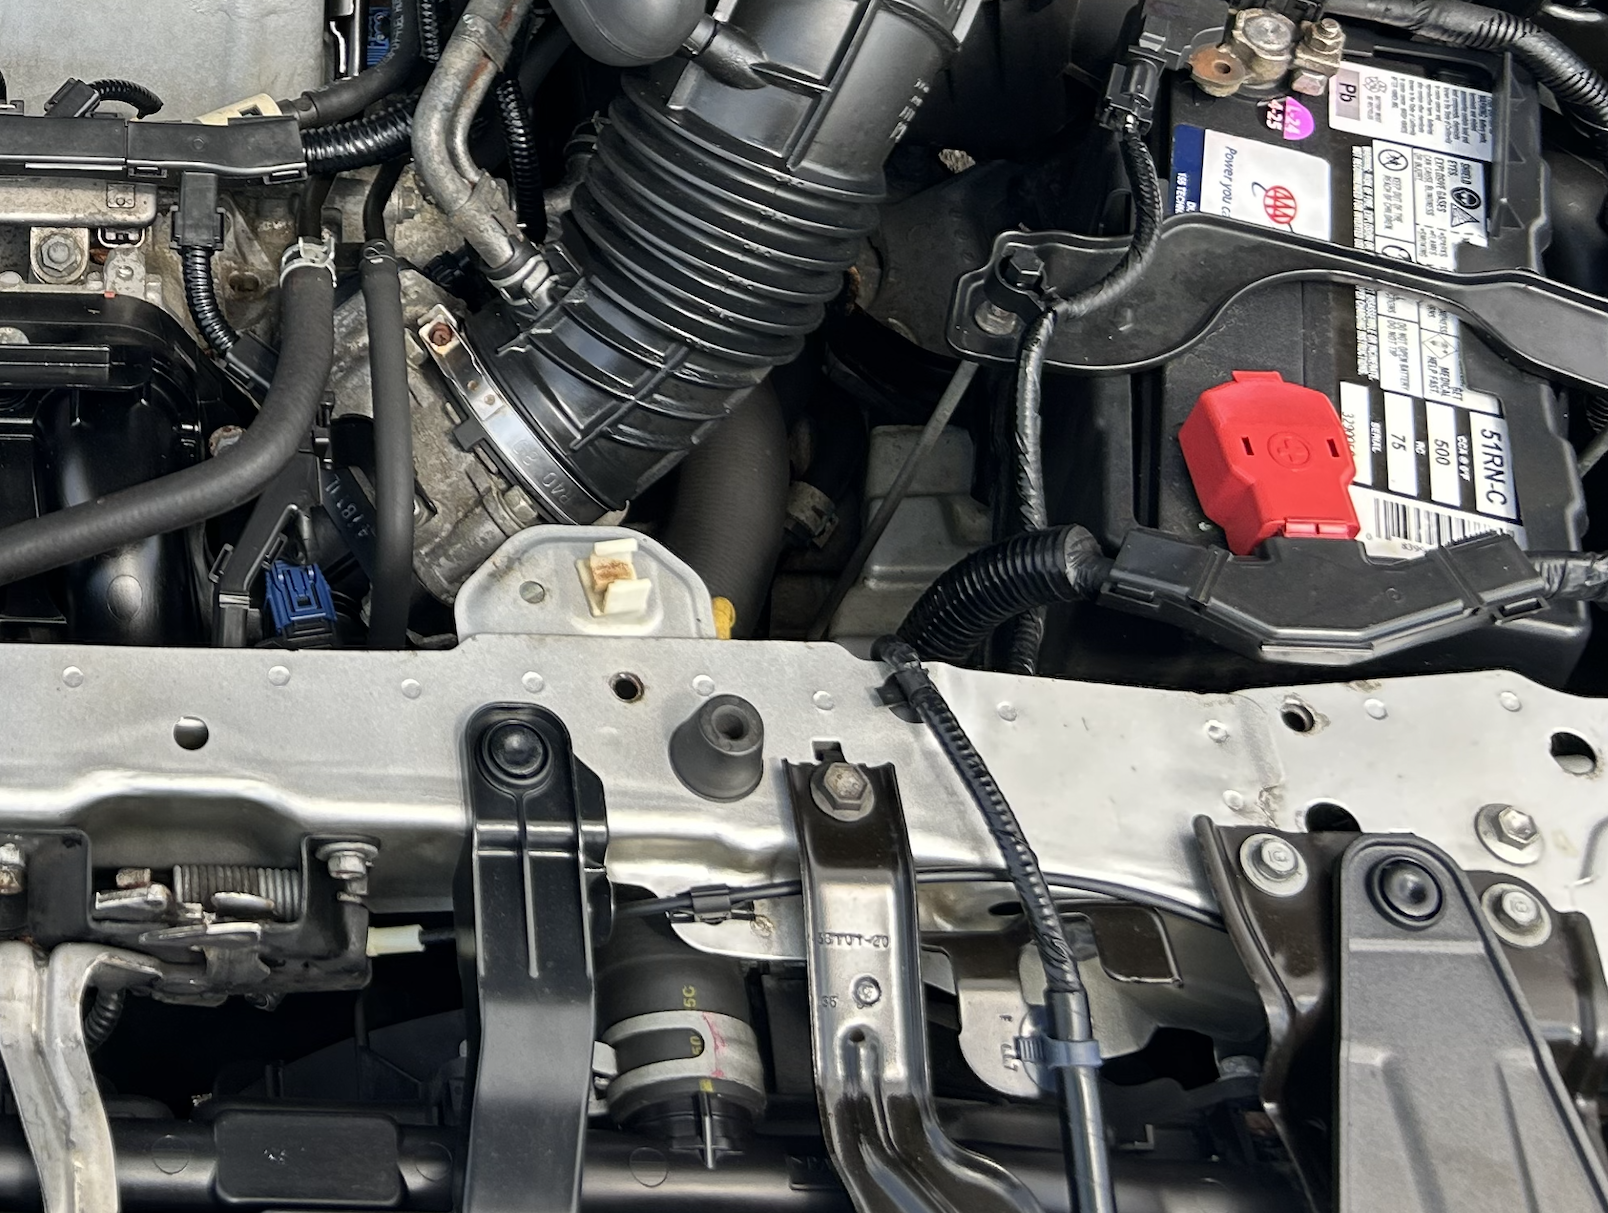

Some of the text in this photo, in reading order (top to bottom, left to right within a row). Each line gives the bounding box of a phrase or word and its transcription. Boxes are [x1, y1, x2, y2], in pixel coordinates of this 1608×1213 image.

[1339, 82, 1357, 102] Pb
[1266, 99, 1283, 130] 4-25
[1223, 146, 1238, 182] Power
[1220, 179, 1233, 205] you
[1434, 157, 1447, 213] EXPLOSIVE GASES
[1265, 189, 1296, 220] AAA
[1428, 356, 1438, 375] HELP
[1437, 366, 1450, 396] MEDICAL
[1452, 387, 1464, 401] GET
[1370, 421, 1383, 454] SERIAL
[1391, 433, 1407, 452] 75
[1415, 440, 1426, 456] RC
[1457, 434, 1469, 454] CCA
[1434, 439, 1451, 466] 500
[1480, 428, 1508, 506] 51RN-C
